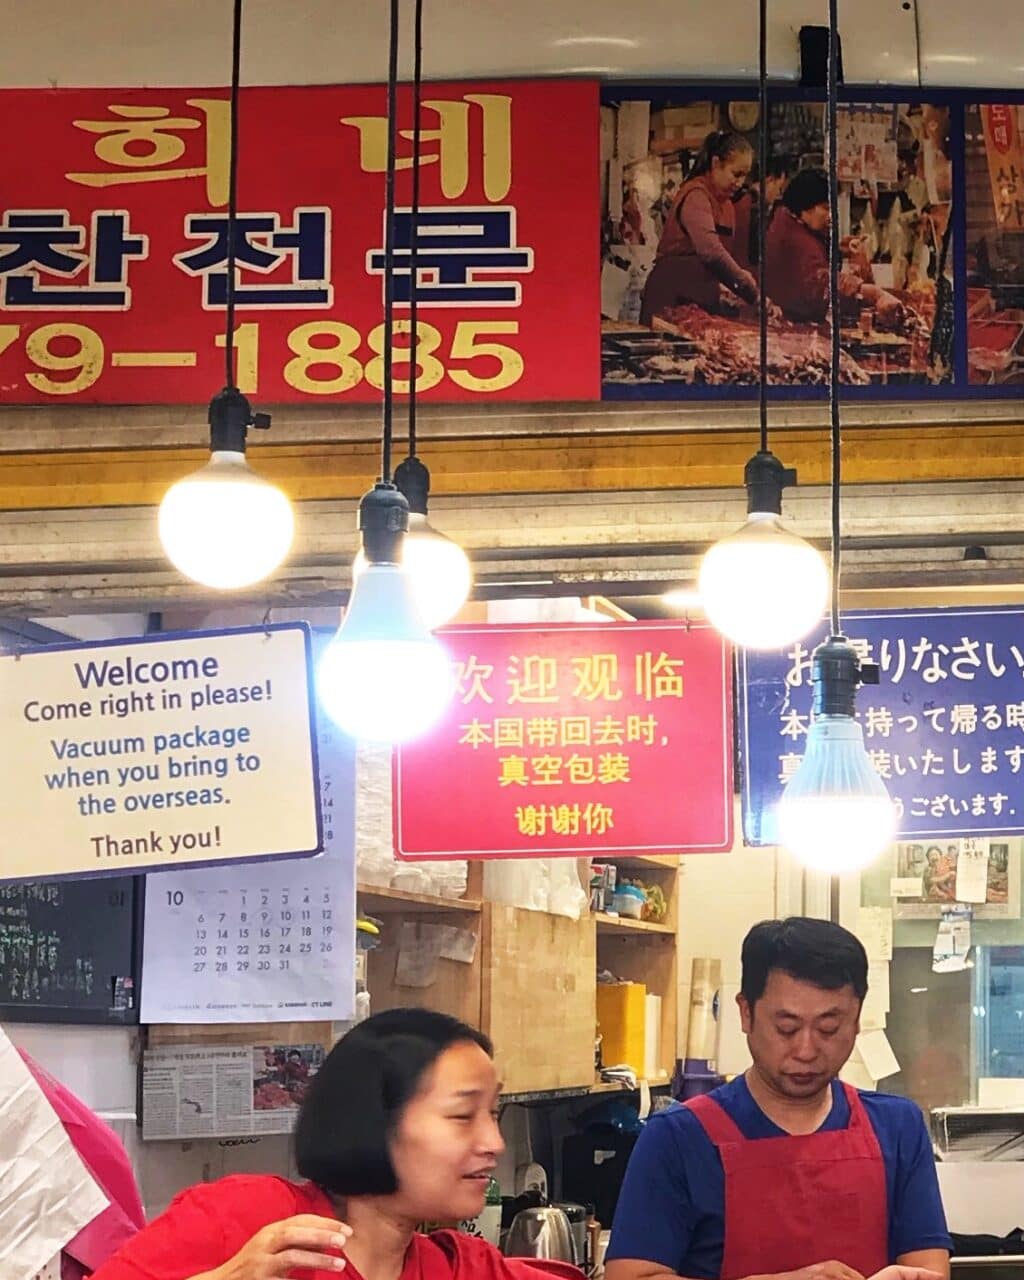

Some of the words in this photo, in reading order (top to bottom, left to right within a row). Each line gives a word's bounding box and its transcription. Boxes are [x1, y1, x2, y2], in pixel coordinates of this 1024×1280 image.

[75, 656, 219, 689] Welcome
[24, 697, 92, 722] Come
[100, 690, 155, 718] right
[162, 689, 181, 709] in
[191, 680, 273, 711] please!
[50, 737, 145, 760] Vacuum
[153, 725, 250, 754] package
[44, 765, 109, 790] when
[118, 762, 160, 787] you
[168, 753, 229, 779] bring
[235, 752, 261, 771] to
[497, 752, 631, 787] 真空包装
[77, 795, 116, 816] the
[124, 784, 232, 812] overseas.
[514, 802, 615, 837] 谢谢你
[90, 831, 163, 859] Thank
[170, 825, 222, 853] you!
[166, 890, 184, 906] 10
[280, 911, 292, 921] 10
[301, 910, 310, 920] 11
[322, 910, 332, 920] 12
[194, 946, 207, 956] 20
[216, 946, 226, 955] 21
[237, 945, 249, 955] 22
[258, 945, 271, 954] 23
[279, 944, 291, 954] 24
[299, 943, 312, 953] 25
[320, 942, 333, 953] 26
[196, 930, 206, 939] 13
[217, 929, 228, 939] 14
[239, 929, 249, 938] 15
[260, 928, 271, 938] 16
[281, 927, 291, 937] 17
[301, 926, 312, 936] 18
[322, 926, 333, 936] 19
[193, 962, 206, 972] 27
[215, 961, 228, 972] 28
[237, 961, 249, 971] 29
[257, 960, 270, 970] 30
[279, 960, 289, 970] 31
